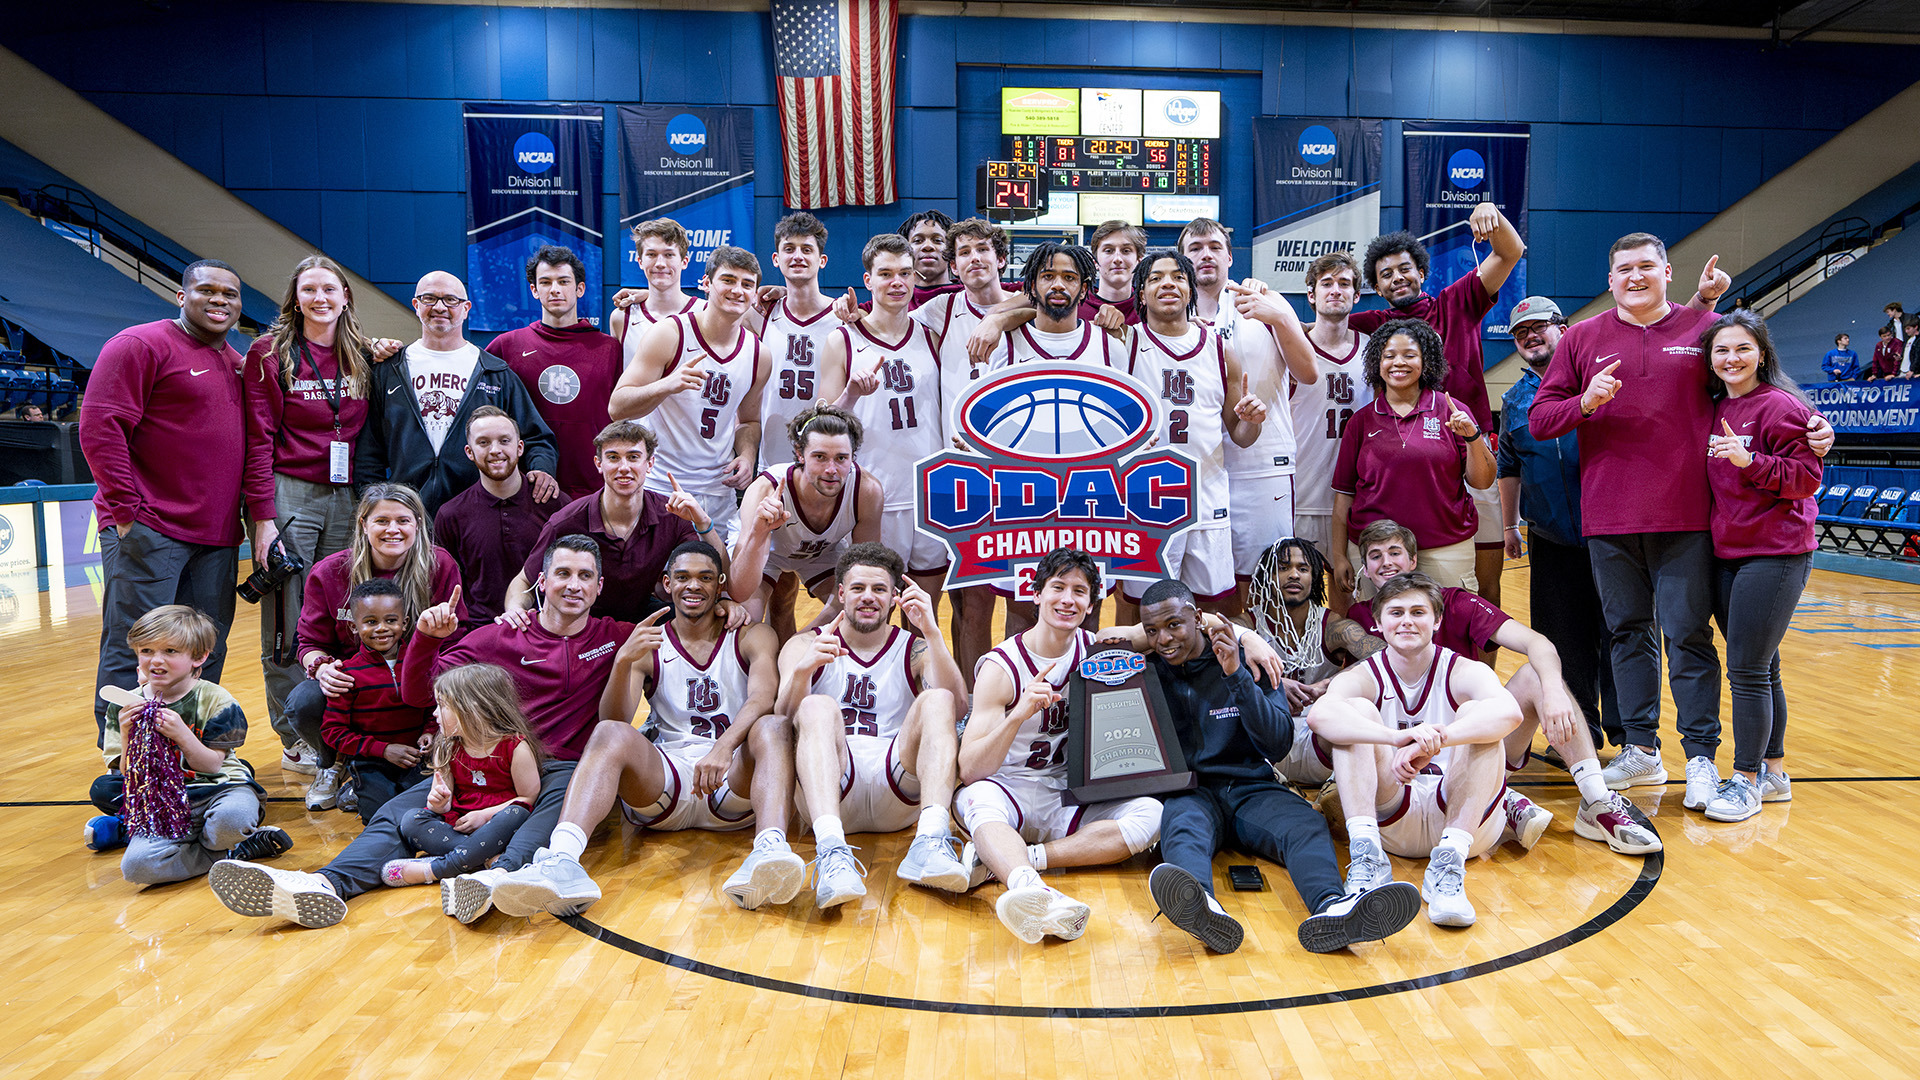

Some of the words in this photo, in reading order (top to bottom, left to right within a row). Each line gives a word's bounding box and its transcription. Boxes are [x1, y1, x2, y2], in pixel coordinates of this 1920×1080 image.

[670, 133, 706, 145] NCAA
[1028, 149, 1034, 157] 0
[1039, 149, 1045, 157] 2
[1090, 140, 1131, 154] 20:24
[1192, 144, 1198, 152] 2
[1302, 144, 1336, 155] NCAA
[518, 151, 554, 163] NCAA
[1059, 147, 1076, 161] 81
[1150, 149, 1167, 162] 56
[1203, 153, 1209, 161] 0
[660, 157, 702, 168] Division
[705, 157, 713, 168] III
[1116, 158, 1123, 169] 2
[1192, 161, 1198, 169] 3
[1177, 169, 1187, 177] 23
[1292, 166, 1332, 178] Division
[1334, 167, 1342, 178] III
[1451, 168, 1484, 179] NCAA
[508, 176, 551, 187] Division
[553, 176, 561, 187] III
[1060, 175, 1067, 186] 9
[1072, 175, 1079, 186] 2
[1142, 177, 1149, 188] 0
[1158, 177, 1168, 188] 10
[1177, 178, 1187, 186] 32
[1203, 178, 1209, 186] 0
[996, 181, 1029, 207] 24
[1441, 190, 1480, 202] Division
[1482, 191, 1490, 202] III
[1274, 260, 1305, 272] FROM
[430, 373, 468, 392] MERC
[779, 369, 815, 400] 35
[1861, 387, 1881, 403] TO
[1883, 385, 1912, 402] THE
[889, 396, 918, 430] 11
[1822, 408, 1919, 427] TOURNAMENT
[700, 408, 719, 439] 5
[1169, 409, 1189, 444] 2
[926, 459, 1188, 530] ODAC
[1828, 486, 1848, 496] SALEM
[1854, 487, 1875, 497] SALEM
[1881, 489, 1901, 500] SALEM
[976, 529, 1141, 559] CHAMPIONS
[585, 647, 613, 661] BASKETBALL
[1080, 653, 1146, 677] ODAC
[1112, 699, 1140, 709] BASKETBALL
[841, 708, 878, 737] 25
[1104, 727, 1141, 742] 2024
[1100, 748, 1151, 762] CHAMPION
